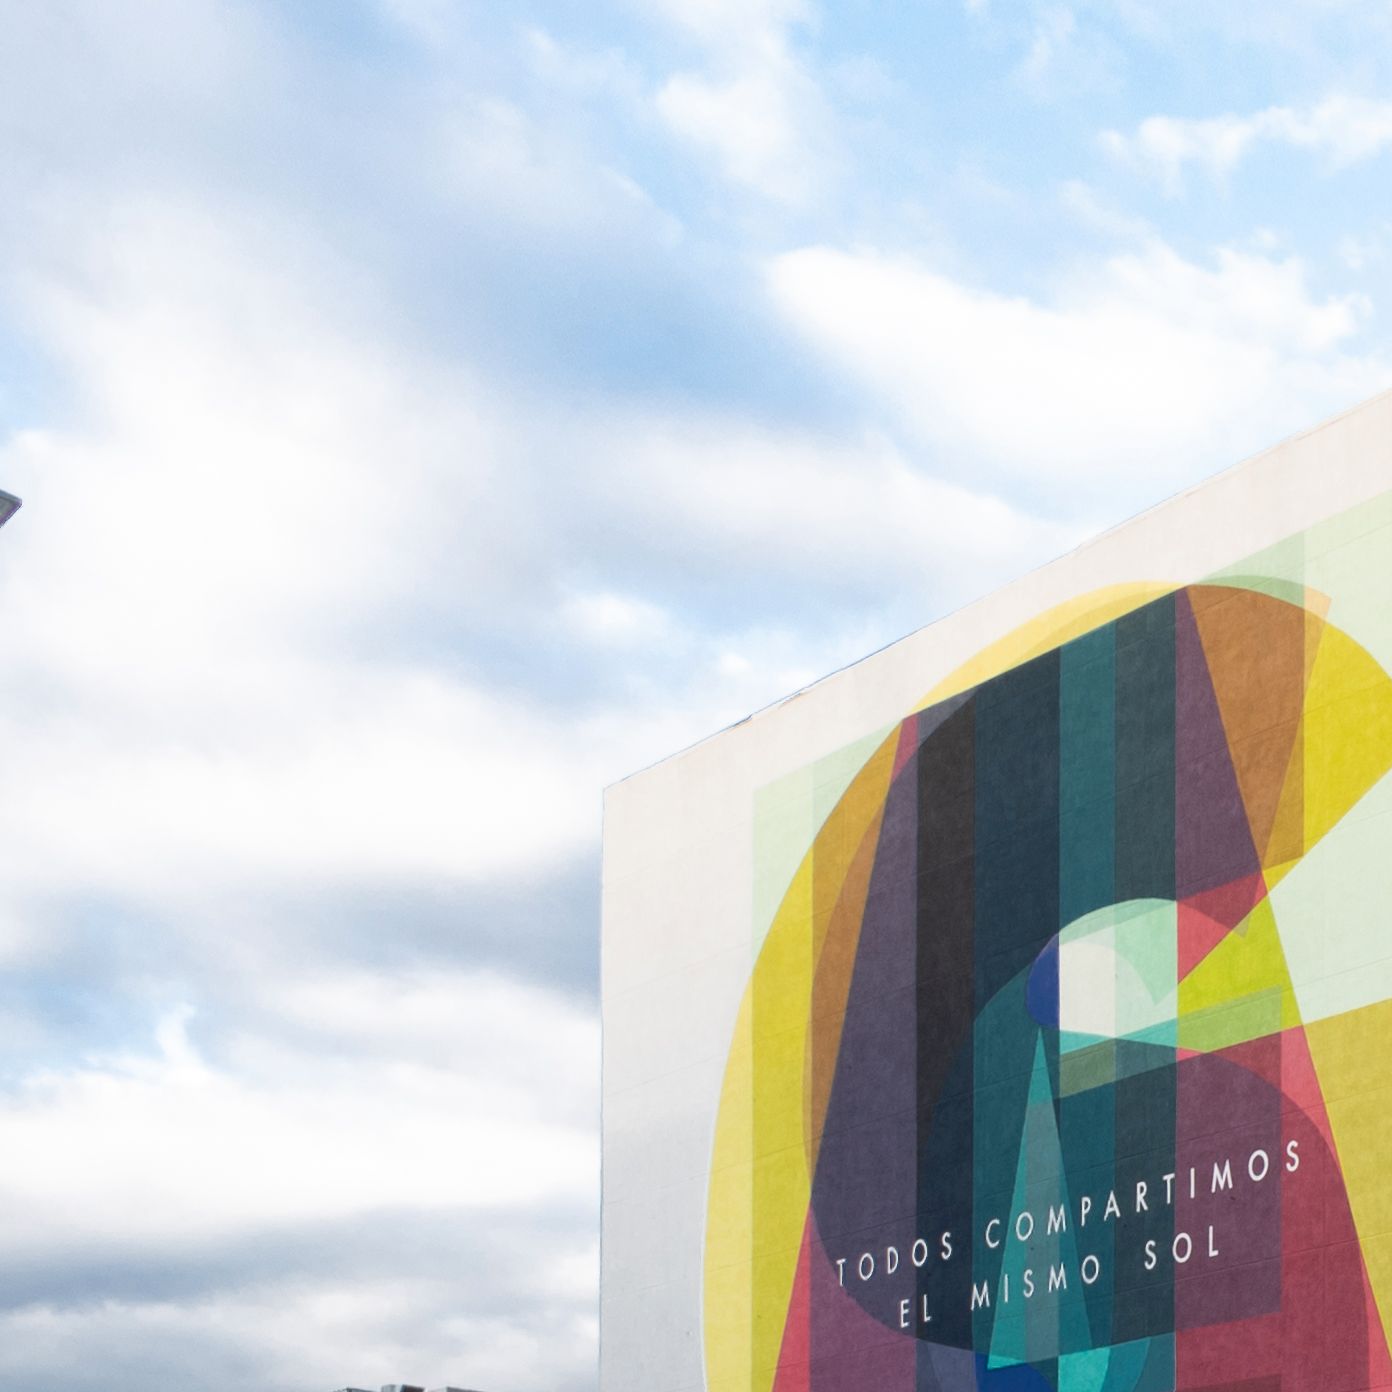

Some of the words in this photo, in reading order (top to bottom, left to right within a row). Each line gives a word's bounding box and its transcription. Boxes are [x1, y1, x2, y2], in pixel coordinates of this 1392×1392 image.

[837, 1231, 953, 1287] TODOS
[985, 1140, 1301, 1249] COMPARTIMOS
[900, 1294, 932, 1329] EL
[970, 1254, 1100, 1311] MISMO
[1144, 1224, 1220, 1271] SOL
